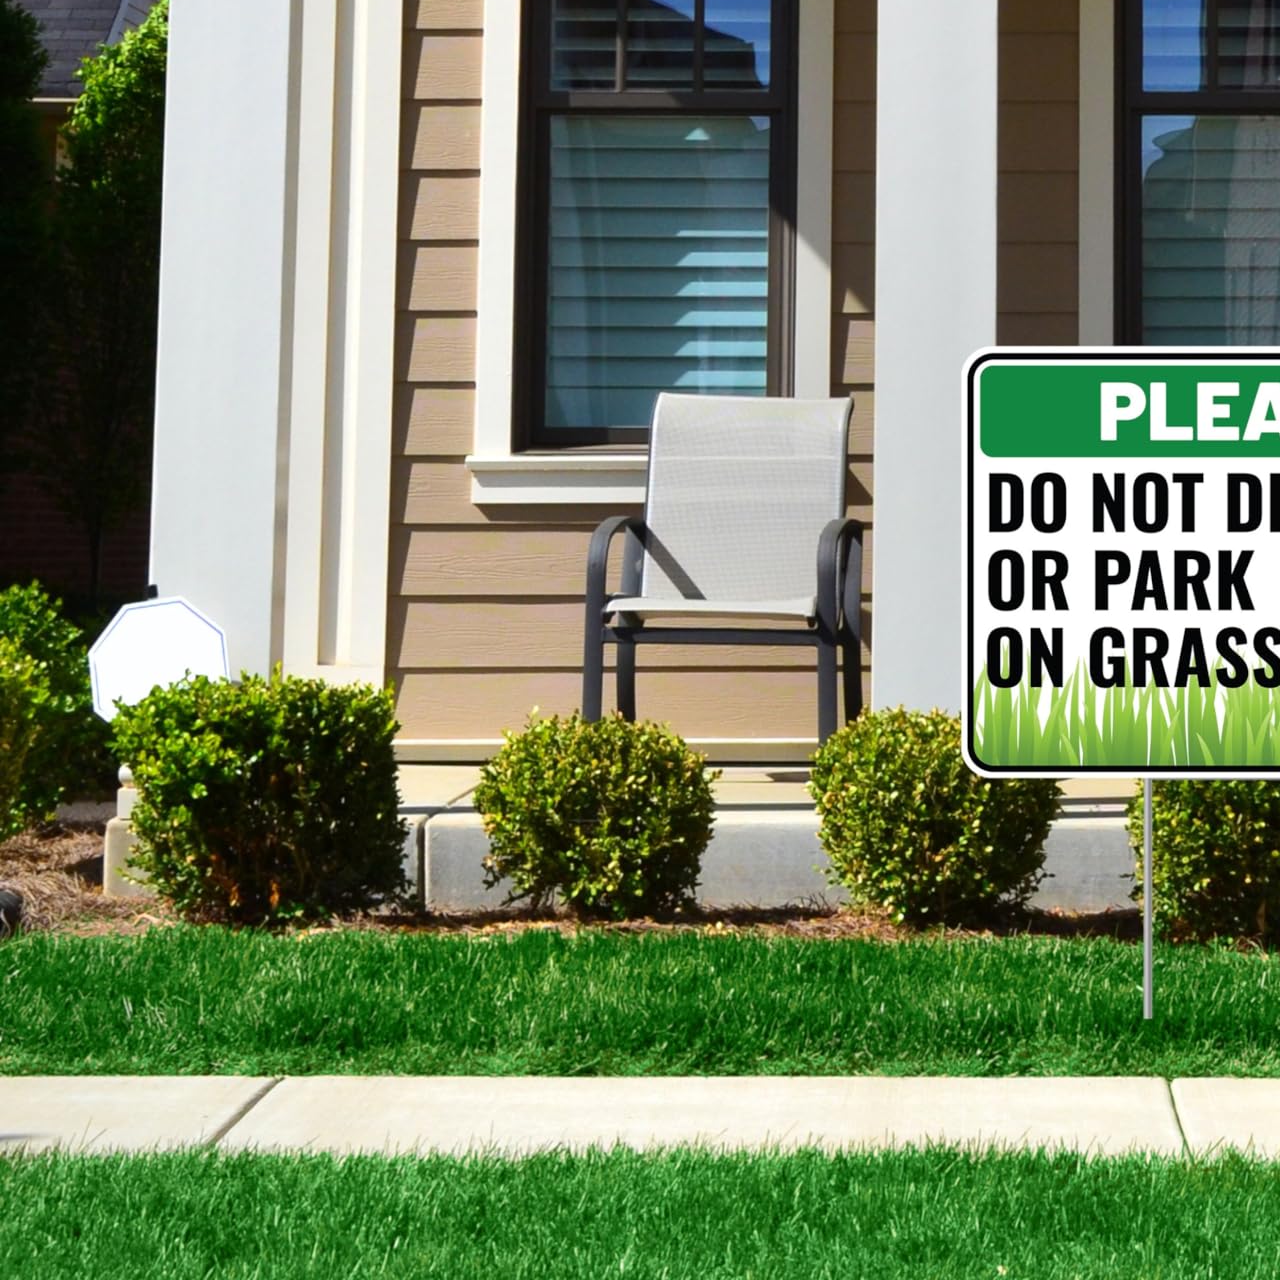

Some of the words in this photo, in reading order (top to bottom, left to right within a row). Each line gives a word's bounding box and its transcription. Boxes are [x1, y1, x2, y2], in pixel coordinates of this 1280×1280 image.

[989, 472, 1067, 534] DO
[1092, 472, 1204, 534] NOT
[988, 549, 1069, 612] OR
[1095, 550, 1255, 611] PARK
[986, 626, 1063, 689] ON
